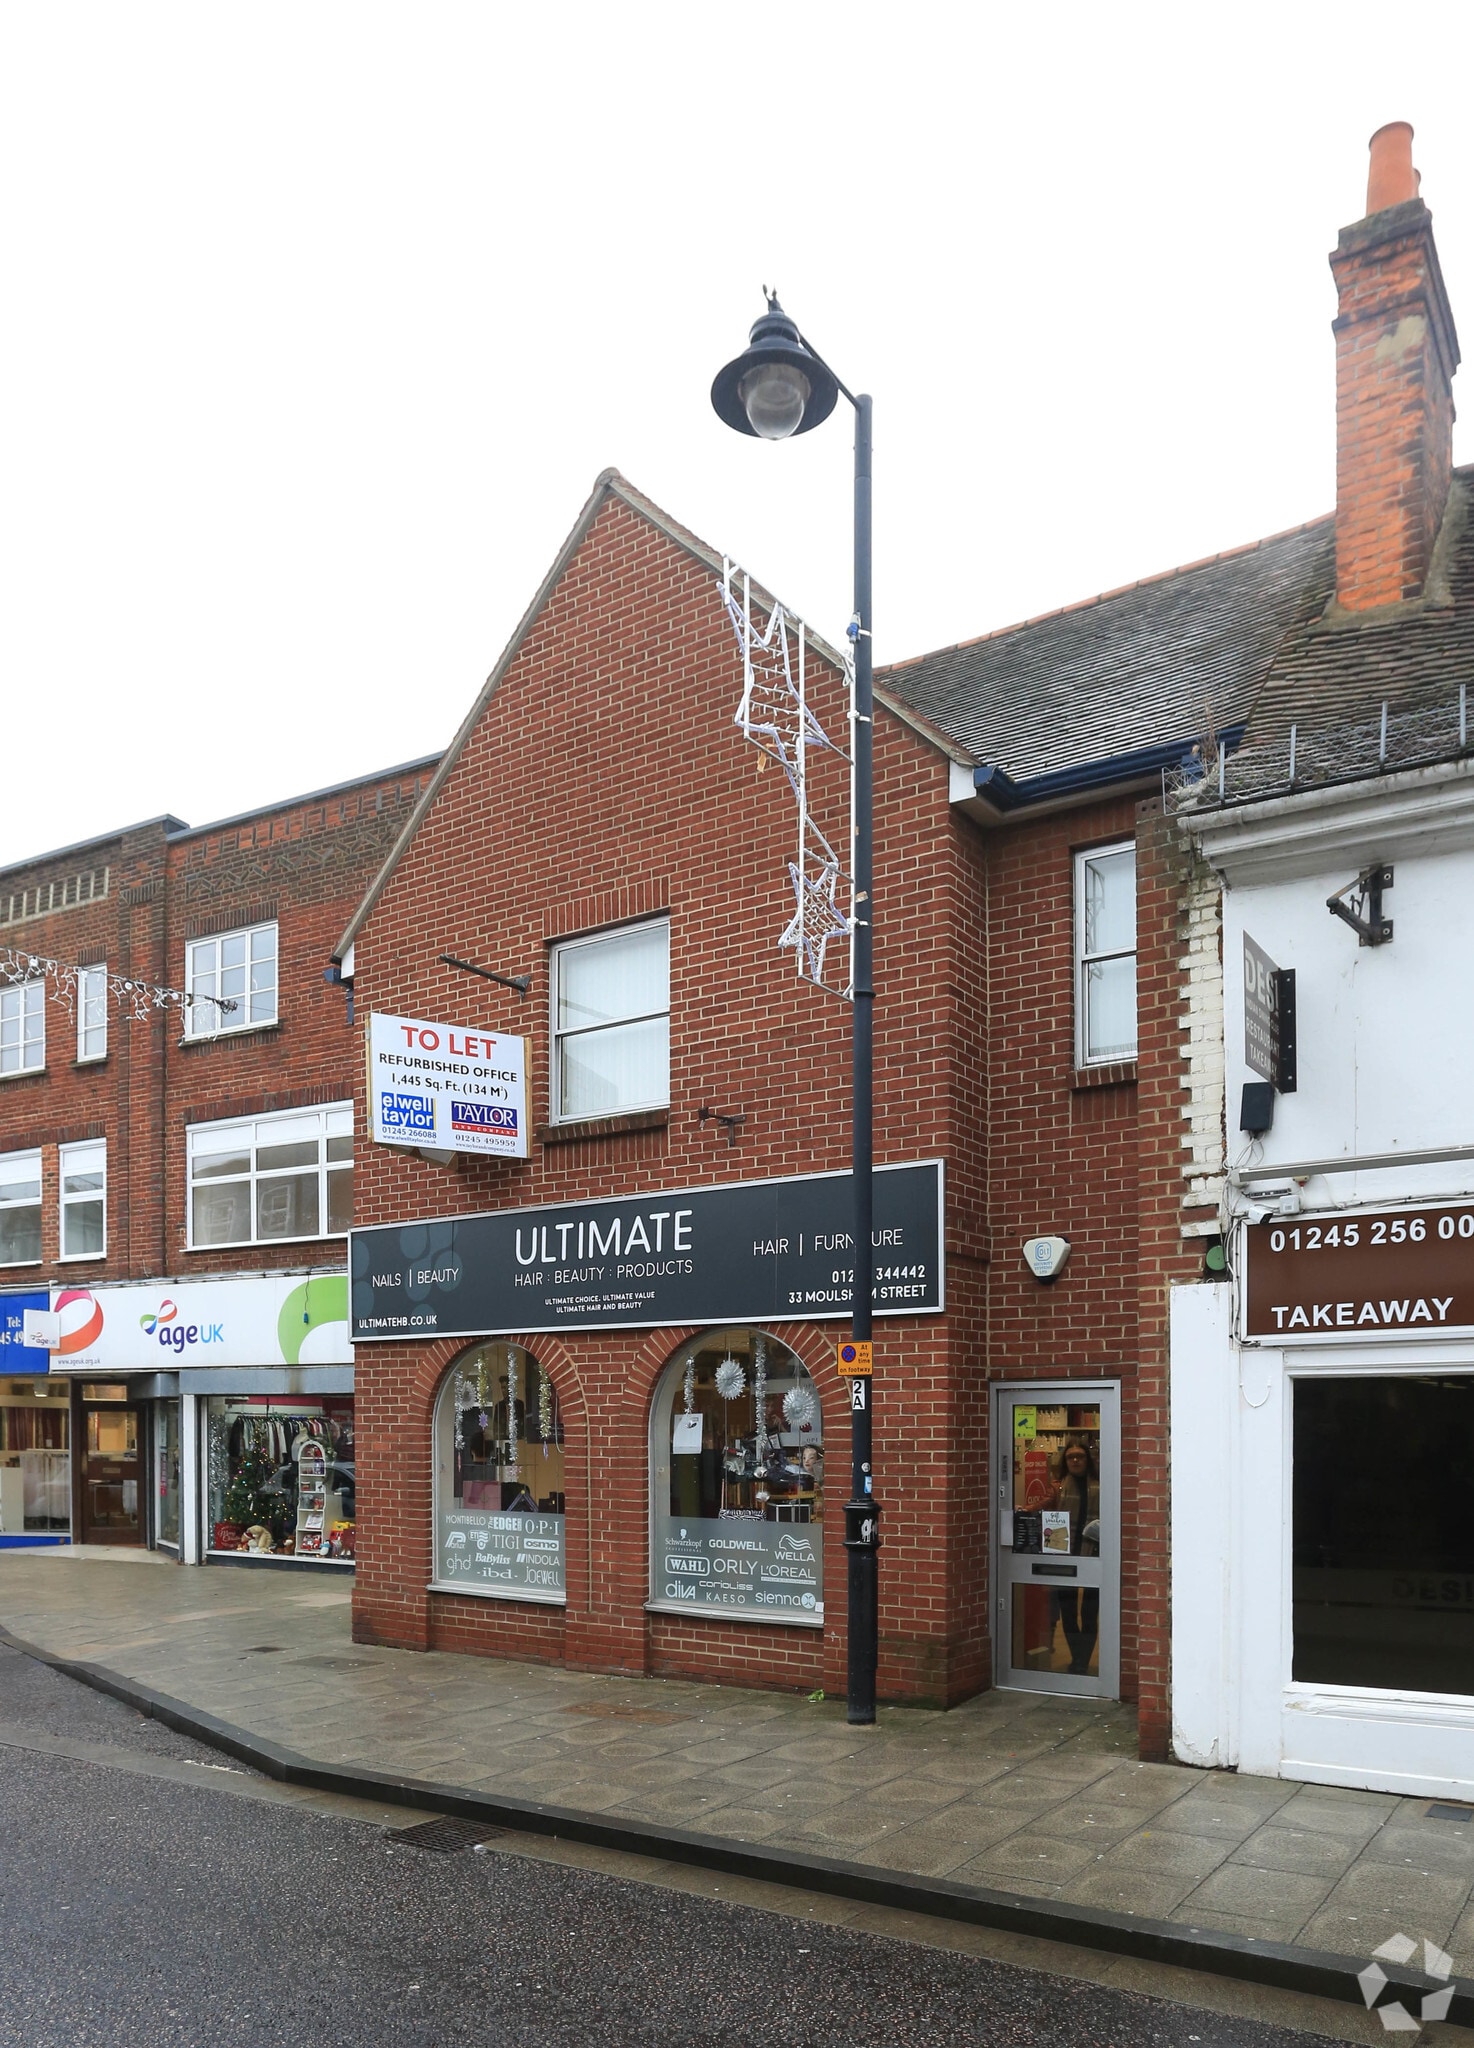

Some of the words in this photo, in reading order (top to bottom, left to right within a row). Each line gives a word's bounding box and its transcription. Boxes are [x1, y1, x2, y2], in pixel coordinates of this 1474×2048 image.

[400, 1025, 440, 1051] TO
[449, 1034, 496, 1060] LET
[379, 1053, 470, 1076] REFURBISHED
[473, 1066, 518, 1082] OFFICE
[392, 1073, 421, 1086] 1,445
[425, 1078, 442, 1092] Sq.
[446, 1080, 460, 1092] Ft.
[382, 1093, 432, 1112] elwell
[382, 1107, 433, 1127] taylor
[454, 1103, 516, 1127] TAYLOR
[382, 1126, 406, 1136] 01245
[408, 1129, 437, 1138] 266088
[456, 1134, 480, 1143] 01245
[484, 1137, 516, 1147] 495959
[515, 1210, 692, 1265] ULTIMATE
[753, 1238, 789, 1256] HAIR
[814, 1228, 904, 1252] FURNURE
[1270, 1223, 1360, 1252] 01245
[1370, 1218, 1426, 1245] 256
[372, 1273, 402, 1288] NAILS
[417, 1268, 459, 1284] BEAUTY
[514, 1272, 544, 1287] HAIR
[554, 1266, 604, 1284] BEAUTY
[616, 1259, 693, 1278] PRODUCTS
[876, 1264, 926, 1280] 344442
[544, 1296, 574, 1306] ULTIMATE
[602, 1292, 634, 1302] ULTIMATE
[788, 1292, 802, 1304] 33
[880, 1284, 927, 1299] STREET
[556, 1304, 586, 1314] ULTIMATE
[586, 1304, 602, 1312] HAIR
[618, 1302, 642, 1310] BEAUTY
[1271, 1297, 1454, 1329] TAKEAWAY
[6, 1316, 21, 1328] Tel:
[359, 1315, 438, 1329] ULTIMATEHB.CO.UK
[446, 1514, 486, 1526] MONTIBELLO
[493, 1516, 518, 1532] EDGE
[492, 1534, 520, 1550] TIGI
[526, 1540, 558, 1550] osmo
[665, 1538, 702, 1548] Schwarzkopf
[446, 1553, 472, 1576] ghd
[526, 1554, 560, 1566] INDOLA
[774, 1551, 816, 1562] WELLA
[670, 1558, 706, 1573] WAHL
[713, 1558, 758, 1575] ORLY
[706, 1592, 746, 1604] KAESO
[755, 1591, 801, 1606] sienna
